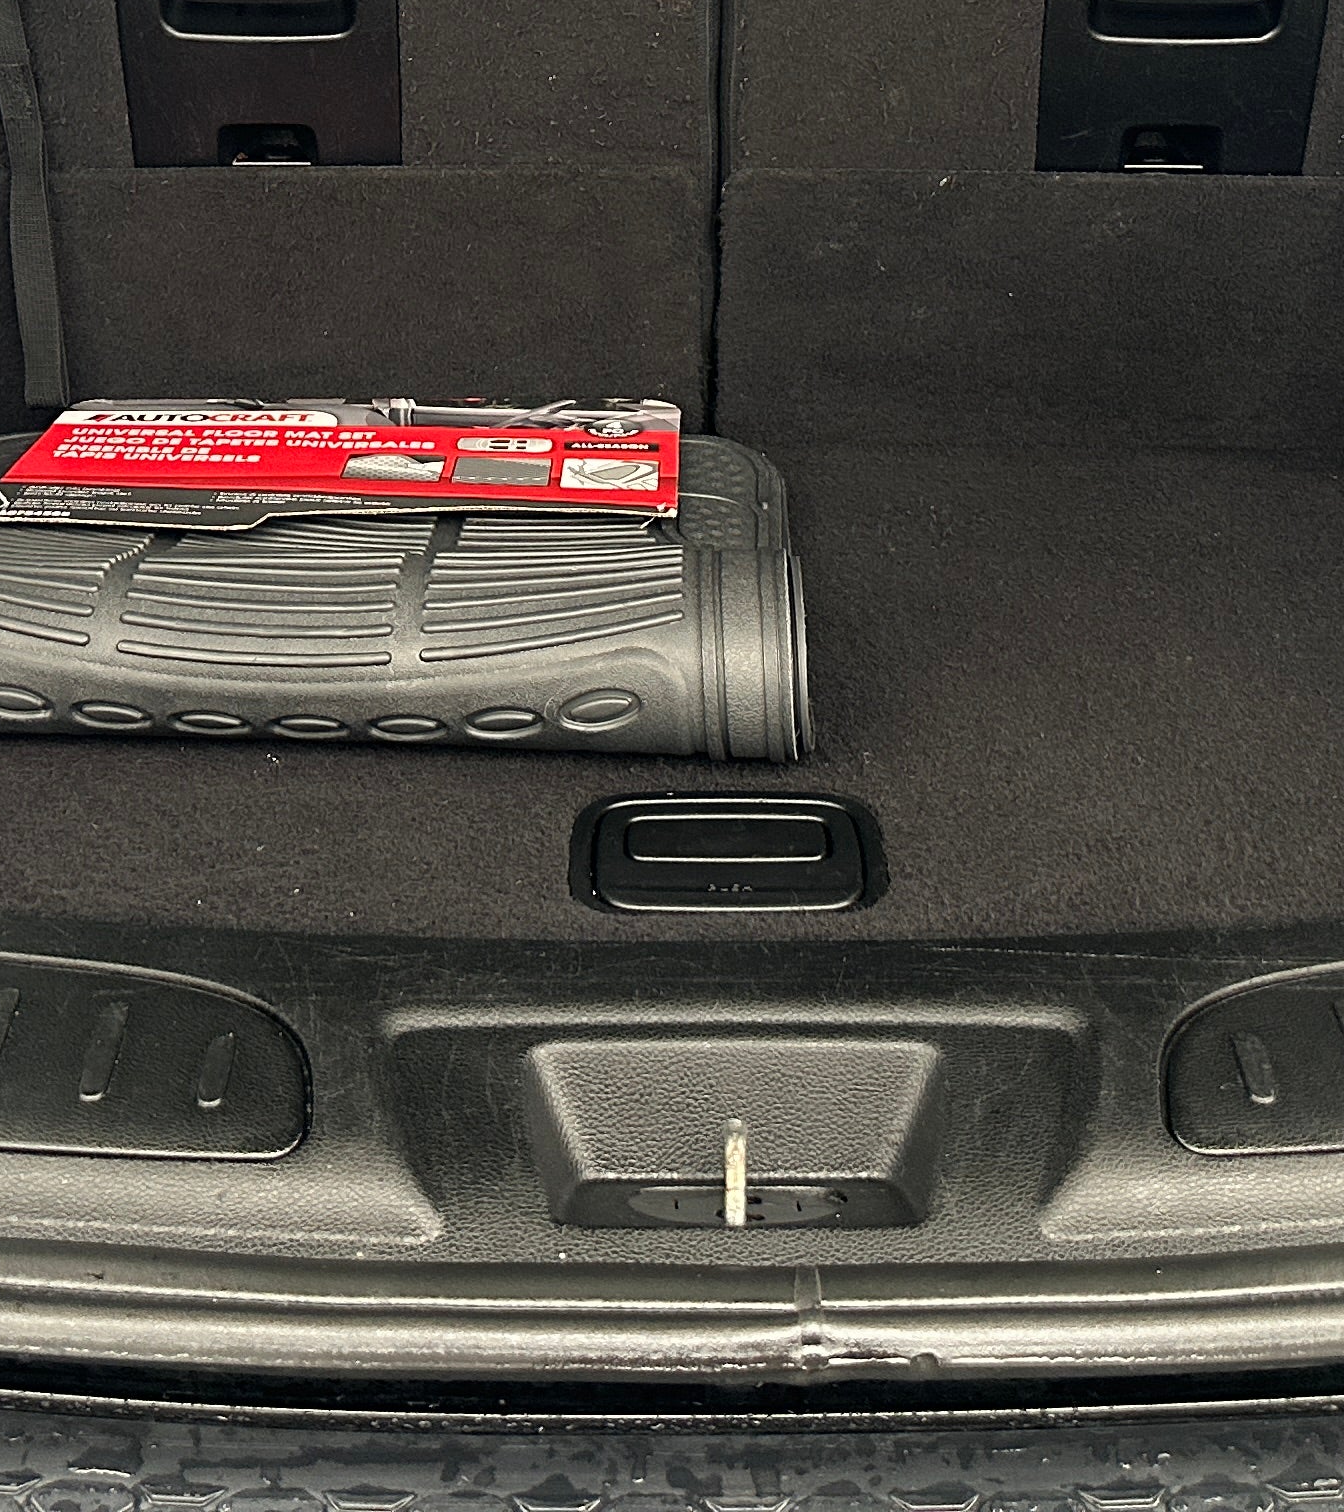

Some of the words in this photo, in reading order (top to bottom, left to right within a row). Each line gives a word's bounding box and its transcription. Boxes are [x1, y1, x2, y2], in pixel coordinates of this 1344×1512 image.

[111, 413, 315, 423] AUTOCRAFT
[71, 427, 196, 437] UNIVERSAL
[202, 429, 279, 438] FLOOR
[284, 431, 333, 440] MAT
[338, 431, 377, 440] SET
[63, 436, 146, 445] JUEGO
[151, 437, 183, 445] DE
[189, 438, 280, 447] TAPETES
[285, 439, 436, 450] UNIVERSALES
[570, 442, 650, 450] ALL-SEASON
[56, 444, 175, 454] ENSEMBLE
[180, 446, 212, 455] DE
[52, 450, 118, 460] TAPIS
[123, 453, 262, 463] UNIVERSELS
